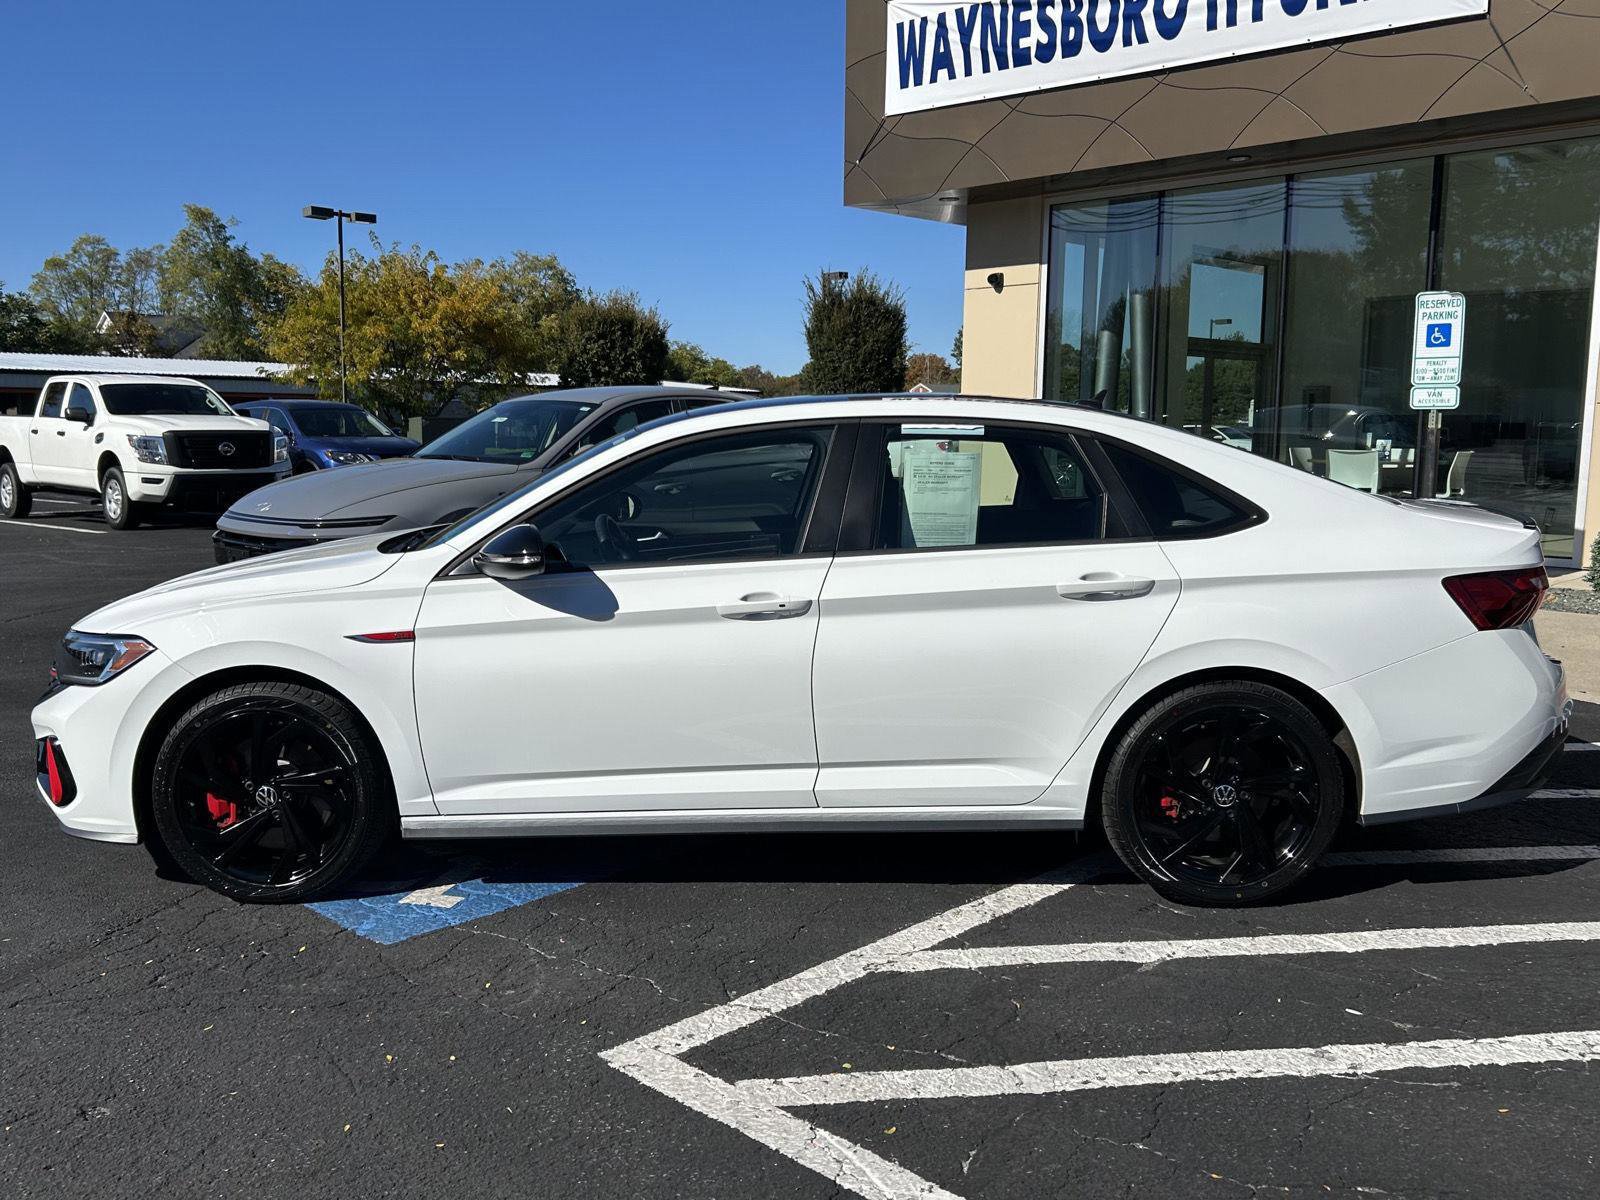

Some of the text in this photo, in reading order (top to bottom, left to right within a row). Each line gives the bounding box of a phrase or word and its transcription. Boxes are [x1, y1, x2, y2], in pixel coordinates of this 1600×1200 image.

[896, 0, 1188, 90] WAYNESBORO
[1420, 299, 1461, 309] RESERVED
[1422, 310, 1459, 321] PARKING
[1426, 390, 1443, 398] VAN
